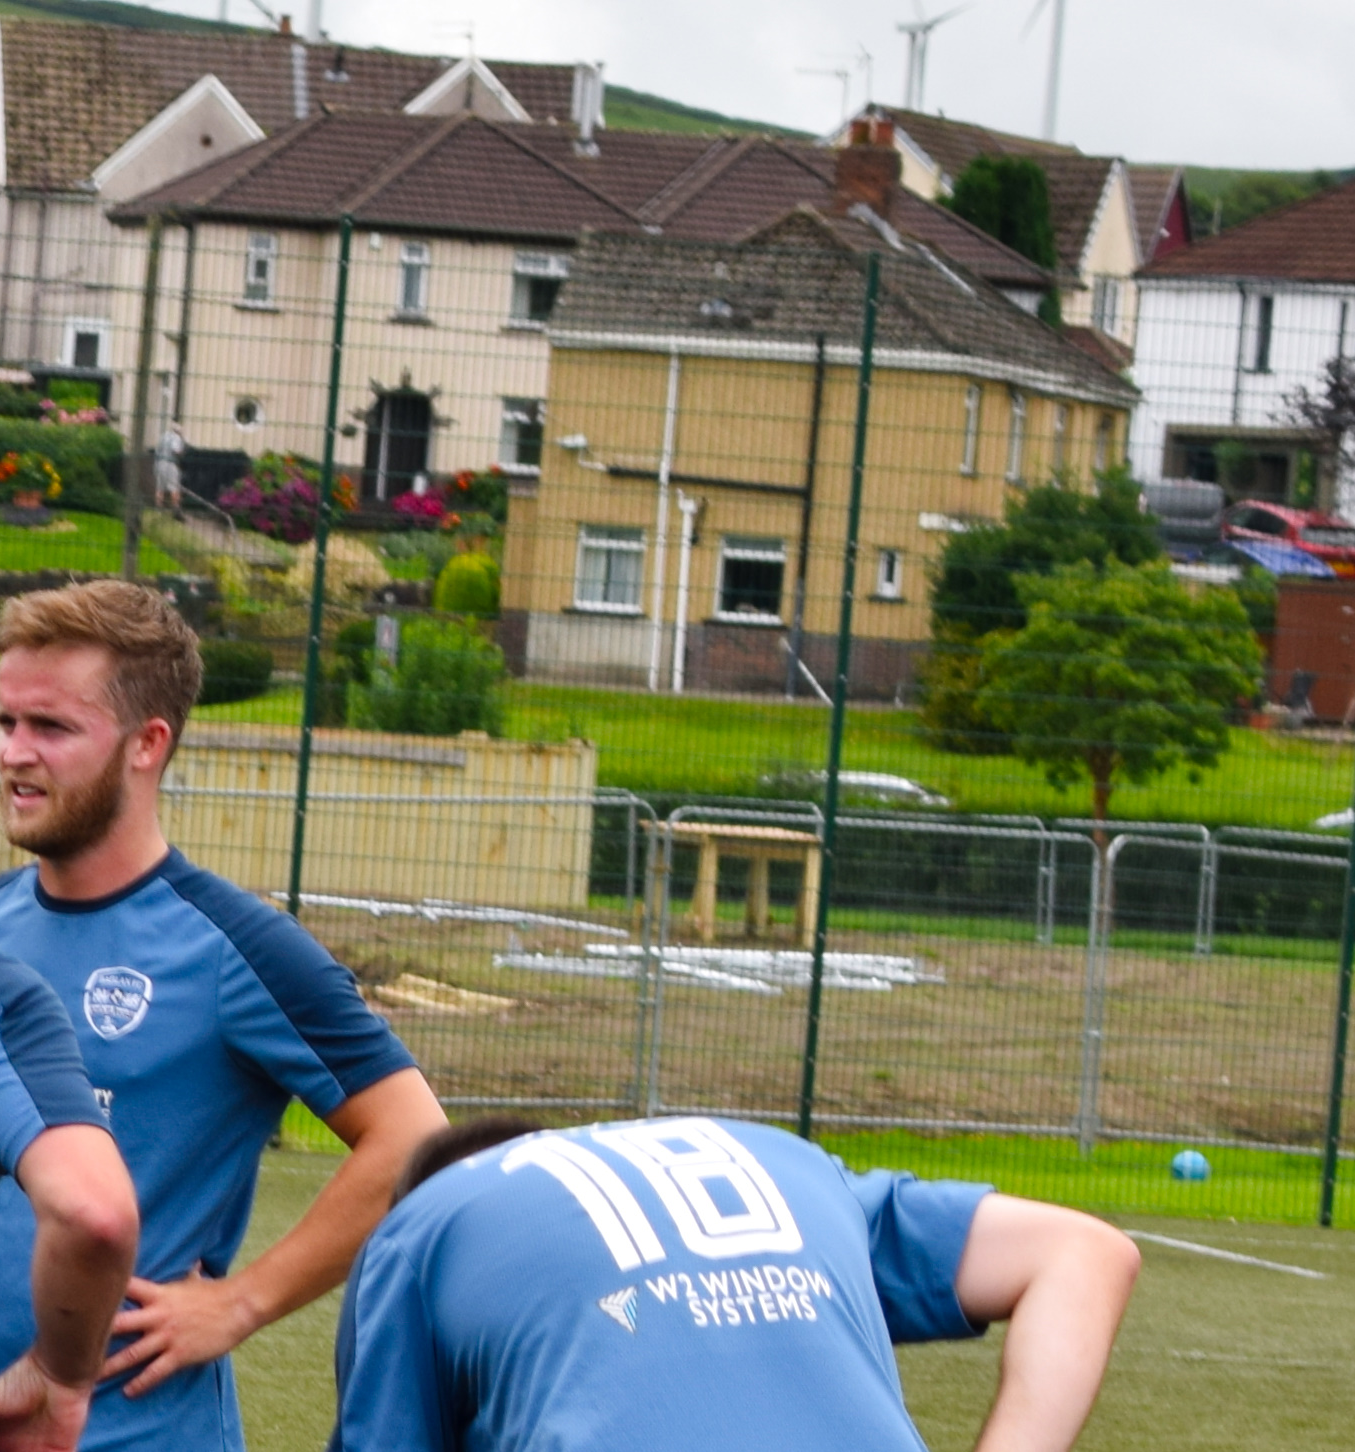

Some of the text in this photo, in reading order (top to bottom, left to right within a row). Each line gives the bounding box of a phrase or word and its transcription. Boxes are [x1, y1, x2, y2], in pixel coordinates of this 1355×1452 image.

[500, 1116, 804, 1272] 18
[645, 1265, 831, 1305] W2 WINDOW
[689, 1291, 818, 1327] SYSTEMS
